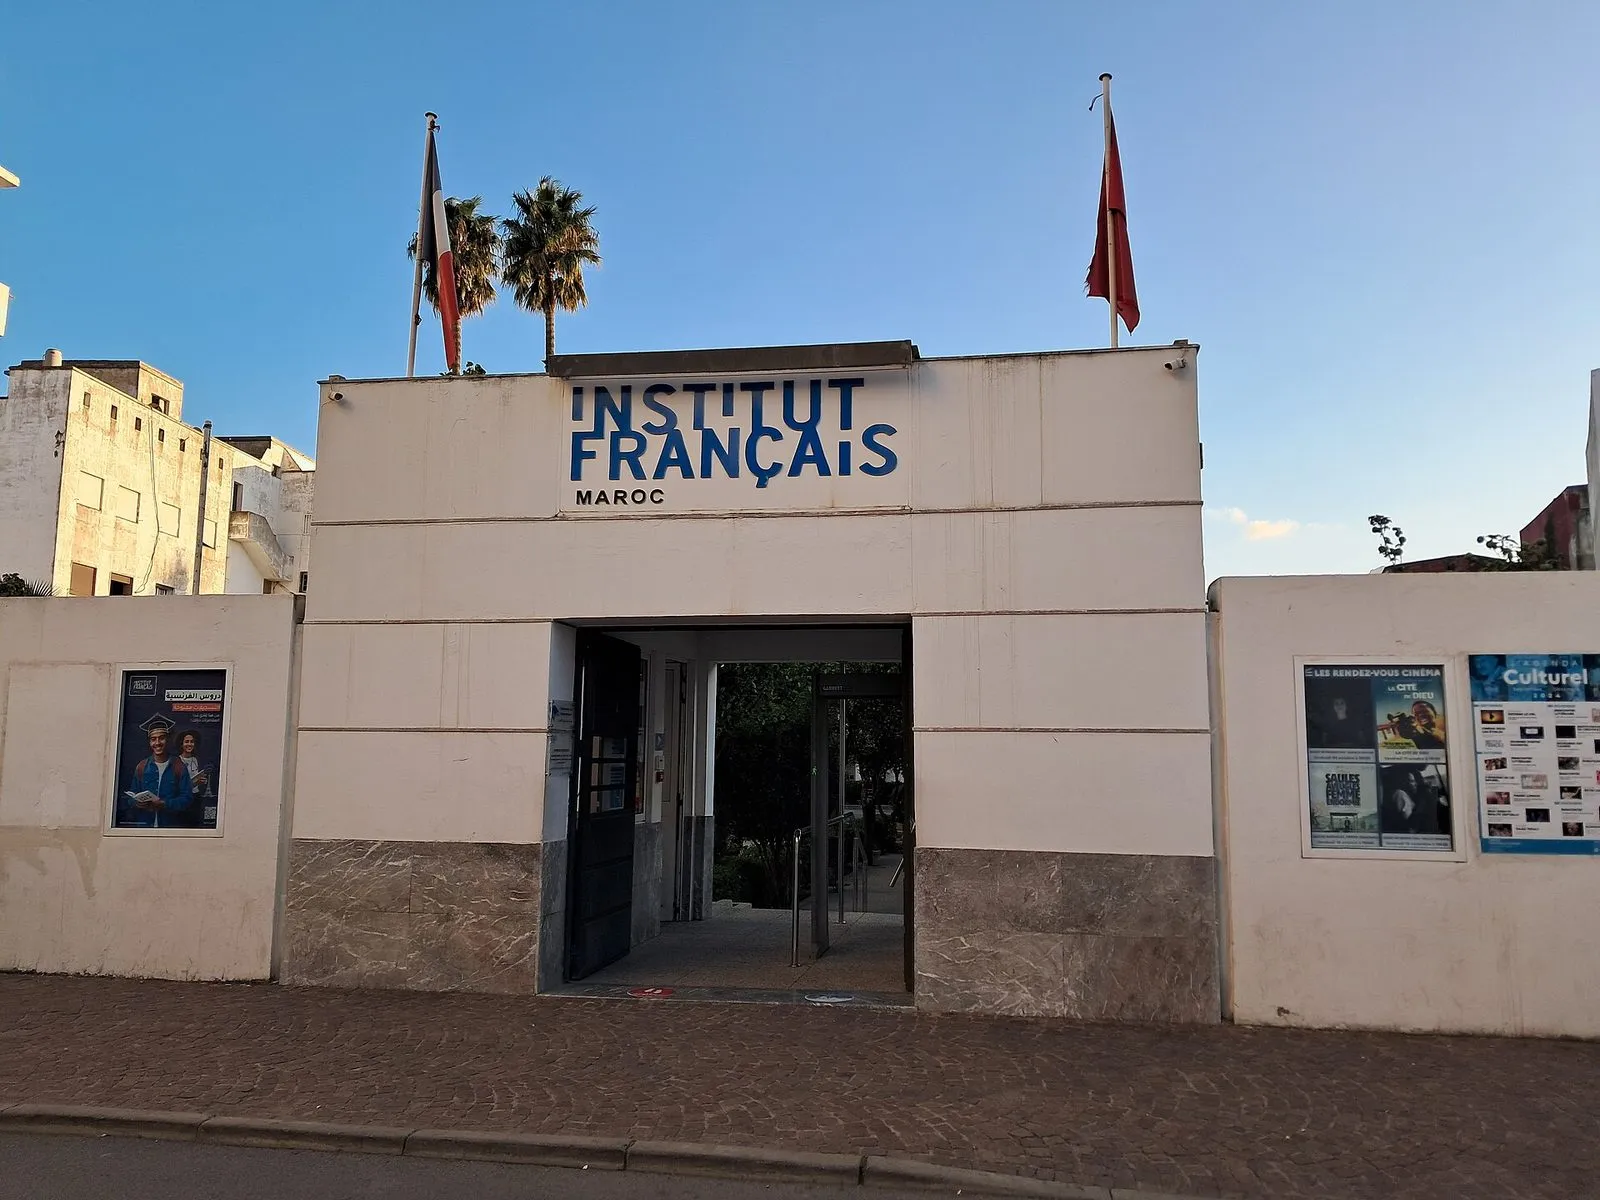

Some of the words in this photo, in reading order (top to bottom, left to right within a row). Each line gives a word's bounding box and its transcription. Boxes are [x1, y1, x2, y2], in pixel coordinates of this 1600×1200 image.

[571, 377, 864, 433] INSTITUT
[570, 423, 897, 488] FRANÇAIS
[575, 489, 665, 505] MAROC
[1314, 669, 1331, 677] LES
[1332, 669, 1400, 677] RENDEZ-VOUS
[1503, 668, 1588, 685] Culturel
[1412, 691, 1434, 699] DIEU
